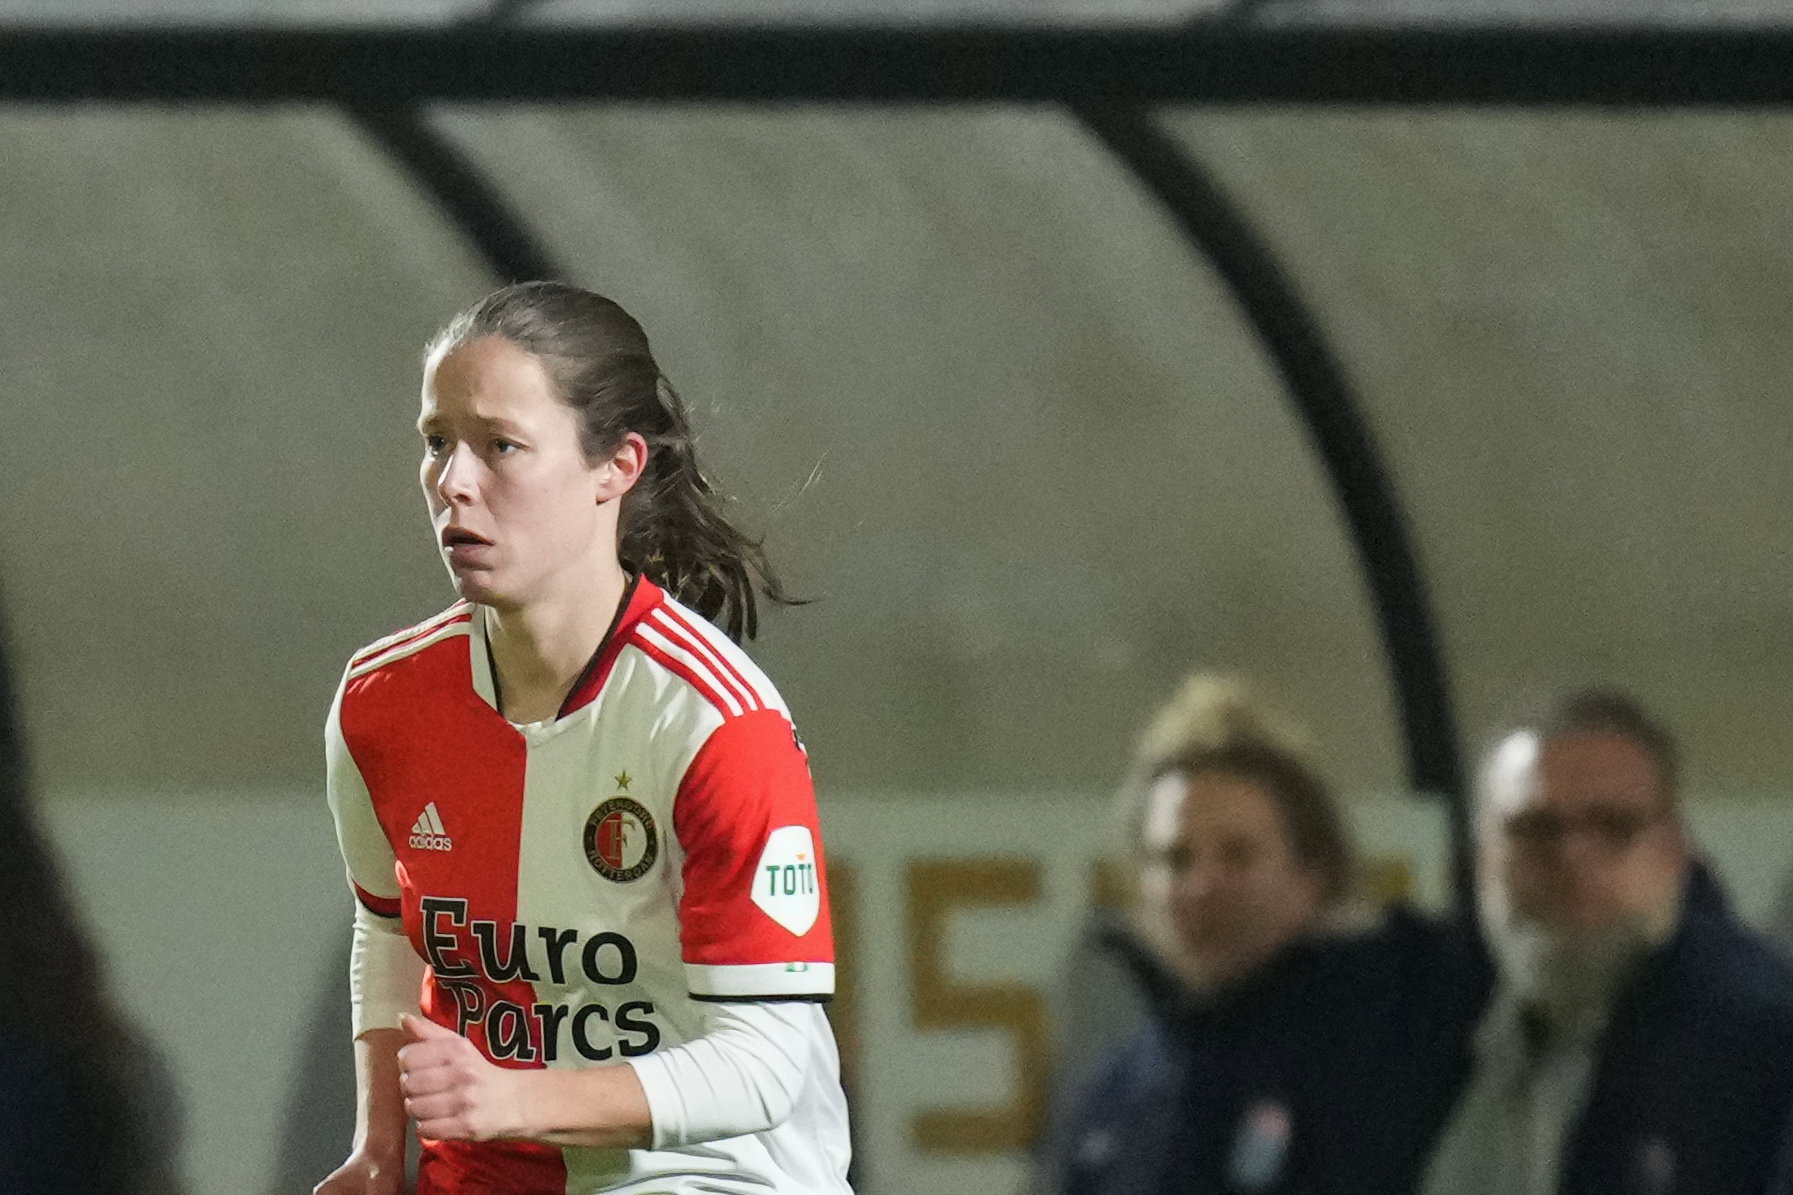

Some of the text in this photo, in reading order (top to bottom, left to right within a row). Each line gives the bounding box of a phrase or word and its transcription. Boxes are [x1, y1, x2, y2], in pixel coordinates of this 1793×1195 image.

[408, 833, 453, 851] adidas
[419, 896, 638, 985] Euro
[439, 980, 661, 1062] Parcs
